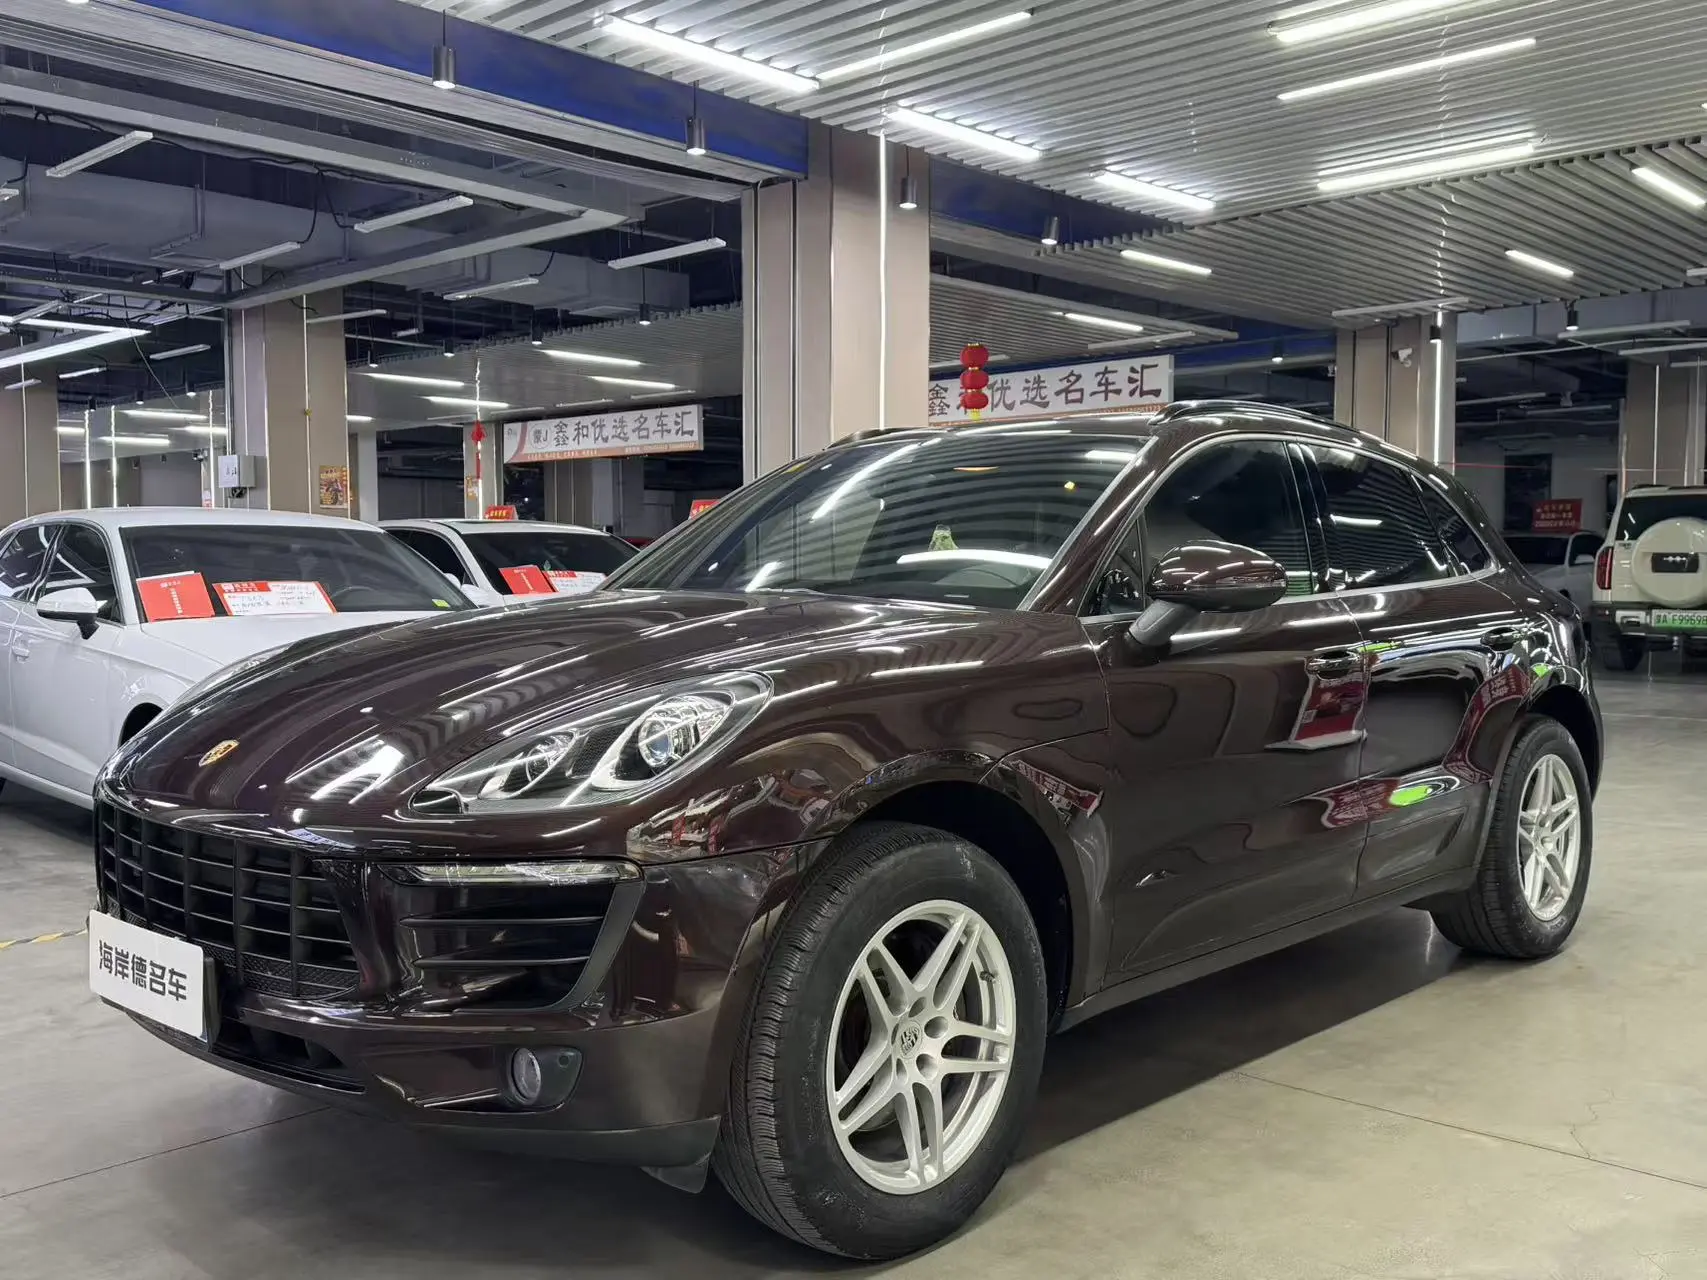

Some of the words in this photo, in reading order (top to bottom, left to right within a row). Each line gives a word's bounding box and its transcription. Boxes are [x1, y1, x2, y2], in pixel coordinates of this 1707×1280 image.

[929, 364, 1162, 416] 鑫优选名车汇
[554, 411, 694, 446] 鑫和优选名车汇
[99, 940, 187, 1001] 海岸德名车
